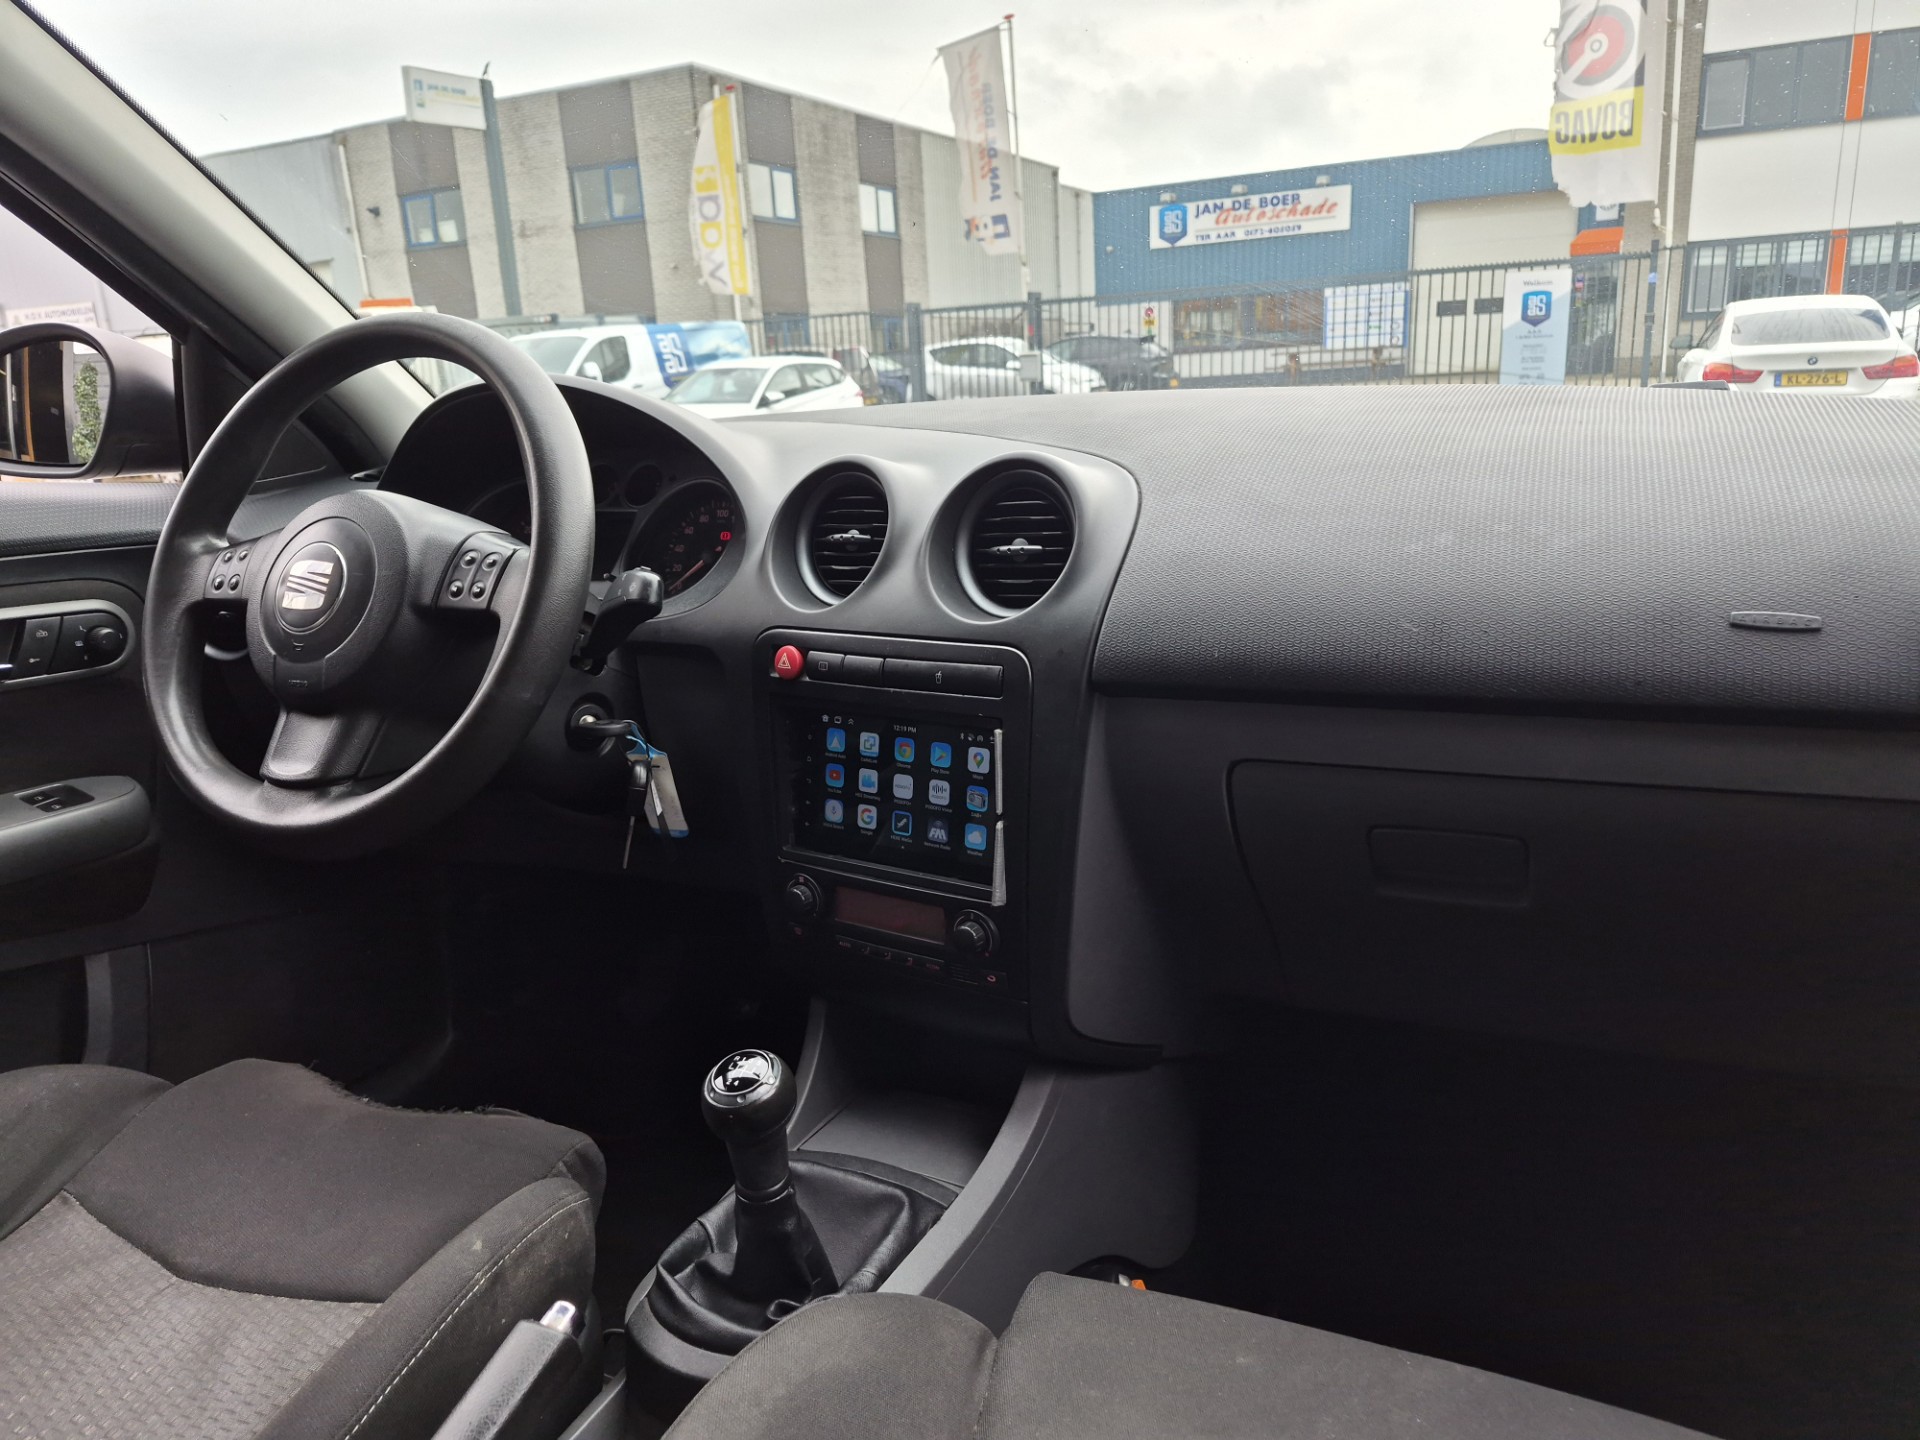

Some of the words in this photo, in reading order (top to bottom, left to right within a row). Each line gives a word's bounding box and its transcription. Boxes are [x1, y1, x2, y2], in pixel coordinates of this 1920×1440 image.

[1194, 202, 1225, 218] JAN
[1231, 199, 1251, 212] DE
[1259, 193, 1302, 209] BOER
[1216, 231, 1236, 240] AAR
[716, 509, 729, 518] 100
[929, 827, 947, 840] FM
[726, 1078, 733, 1086] 2
[733, 1079, 740, 1087] 4
